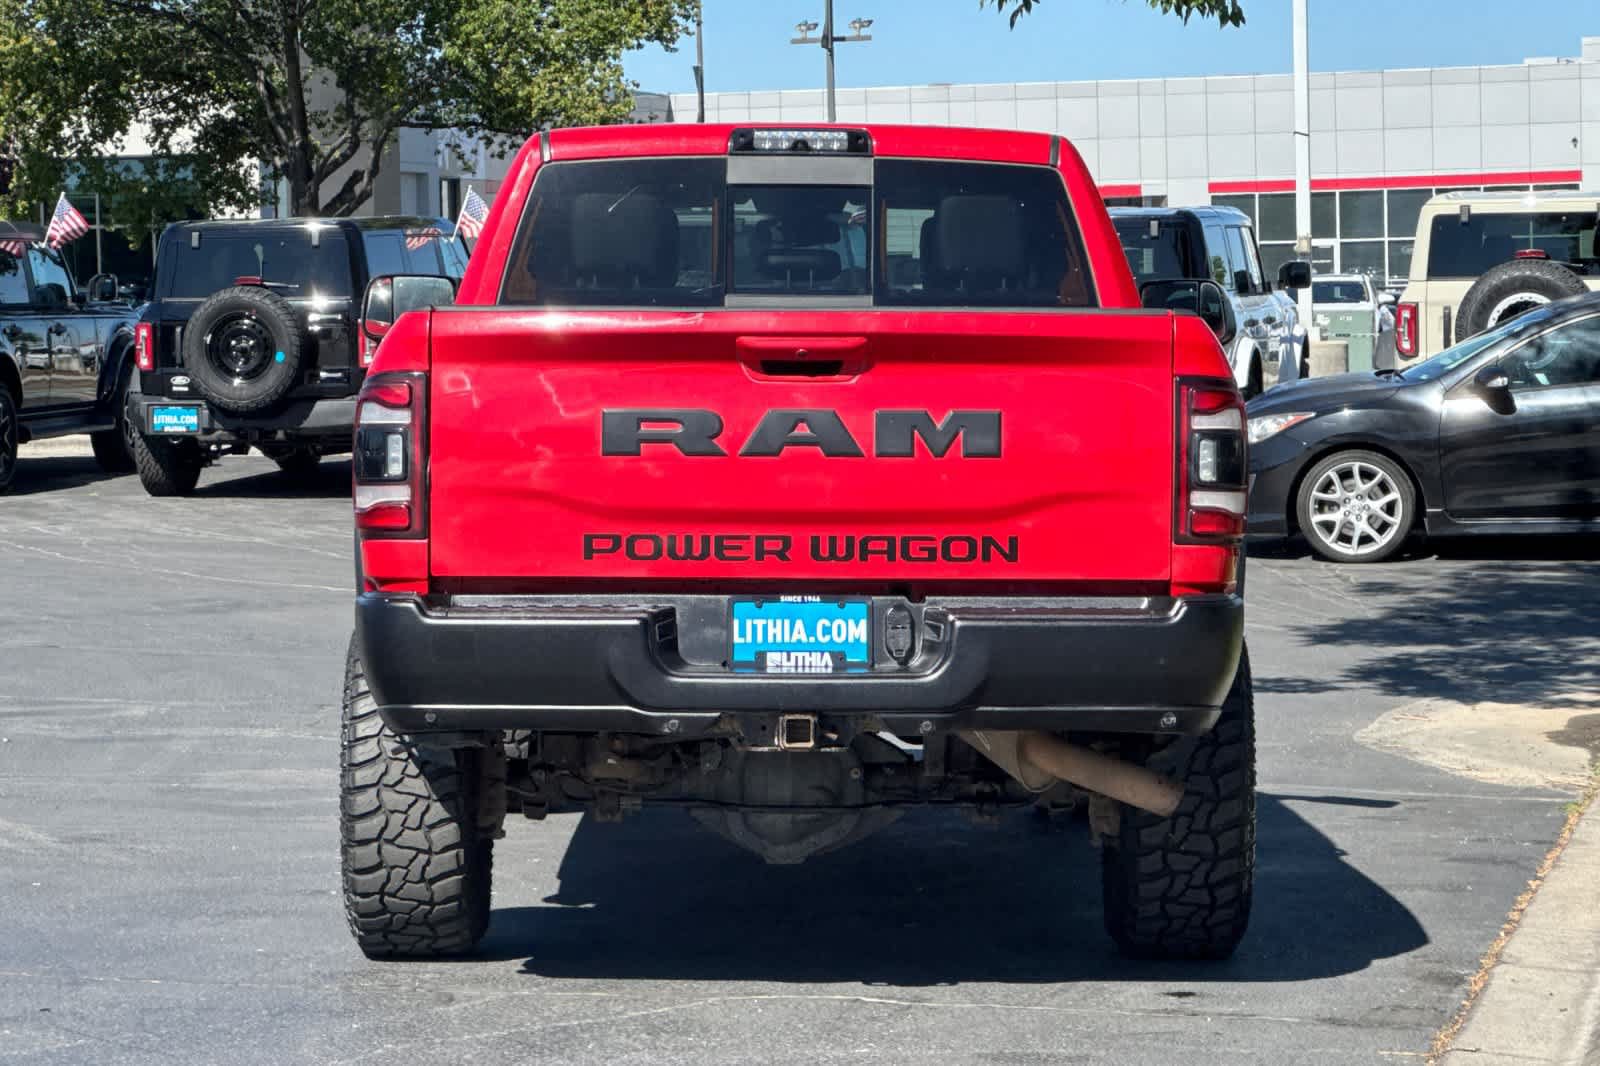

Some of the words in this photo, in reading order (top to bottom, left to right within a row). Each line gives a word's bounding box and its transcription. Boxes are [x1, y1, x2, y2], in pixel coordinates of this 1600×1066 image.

[601, 408, 1003, 458] RAM
[583, 533, 793, 562] POWER
[810, 534, 1019, 563] WAGON
[733, 618, 867, 644] LITHIA.COM
[781, 651, 832, 667] LITHIA
